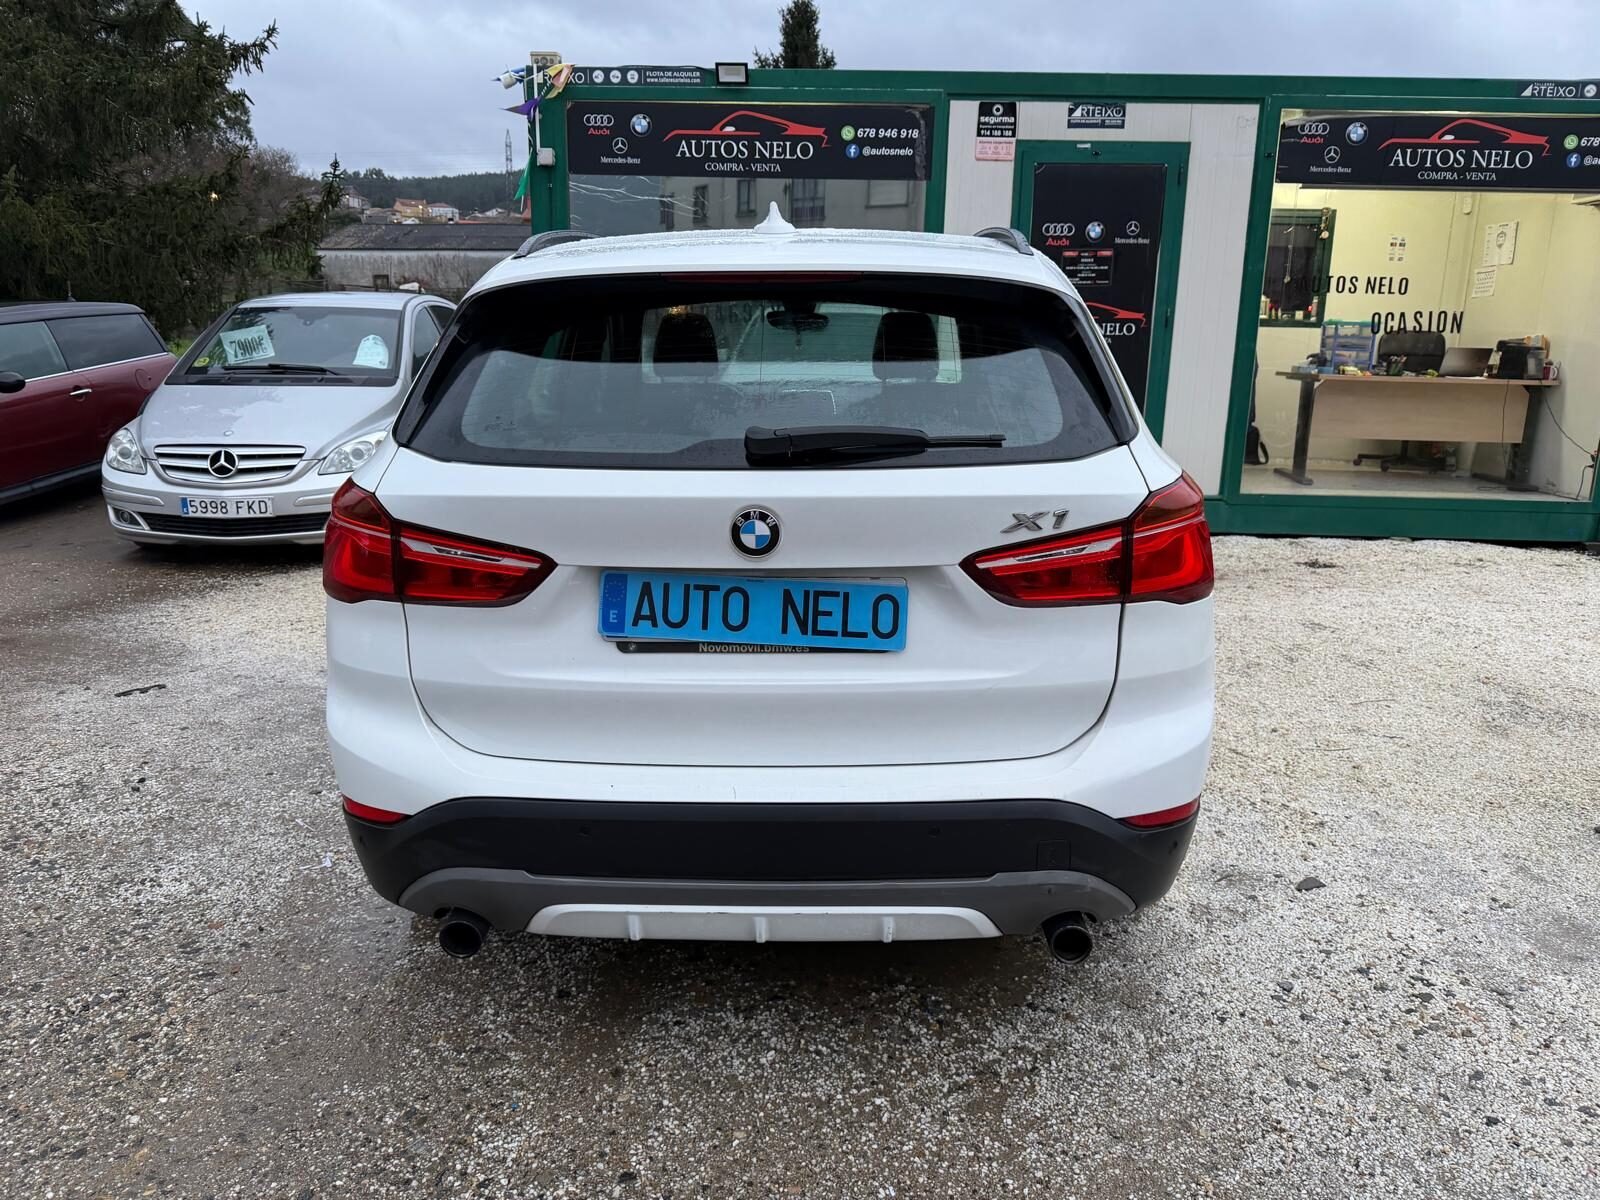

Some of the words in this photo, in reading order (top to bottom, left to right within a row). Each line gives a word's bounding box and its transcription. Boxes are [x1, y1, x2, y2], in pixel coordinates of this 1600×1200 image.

[980, 115, 1015, 124] segurma
[588, 127, 611, 136] Audi
[857, 128, 876, 138] 678
[878, 128, 898, 138] 946
[900, 128, 920, 139] 918
[1300, 136, 1324, 144] Audi
[1580, 136, 1600, 147] 678
[676, 140, 749, 159] AUTOS
[754, 141, 814, 160] NELO
[862, 146, 914, 157] @autosnelo
[600, 155, 641, 164] Mercedes-Benz
[1388, 148, 1466, 168] AUTOS
[1470, 149, 1533, 169] NELO
[704, 162, 744, 172] COMPRA
[751, 163, 781, 172] VENTA
[1417, 171, 1458, 180] COMPRA
[1466, 172, 1497, 181] VENTA
[1045, 238, 1070, 246] Audi
[1365, 276, 1409, 295] NELO
[1370, 310, 1464, 335] OCASION
[228, 335, 267, 359] 7900€
[188, 499, 228, 514] 5998
[235, 500, 268, 515] FKD
[735, 510, 777, 527] BMW
[1000, 509, 1071, 534] X1
[609, 610, 618, 623] E
[631, 581, 750, 633] AUTO
[780, 587, 900, 640] NELO
